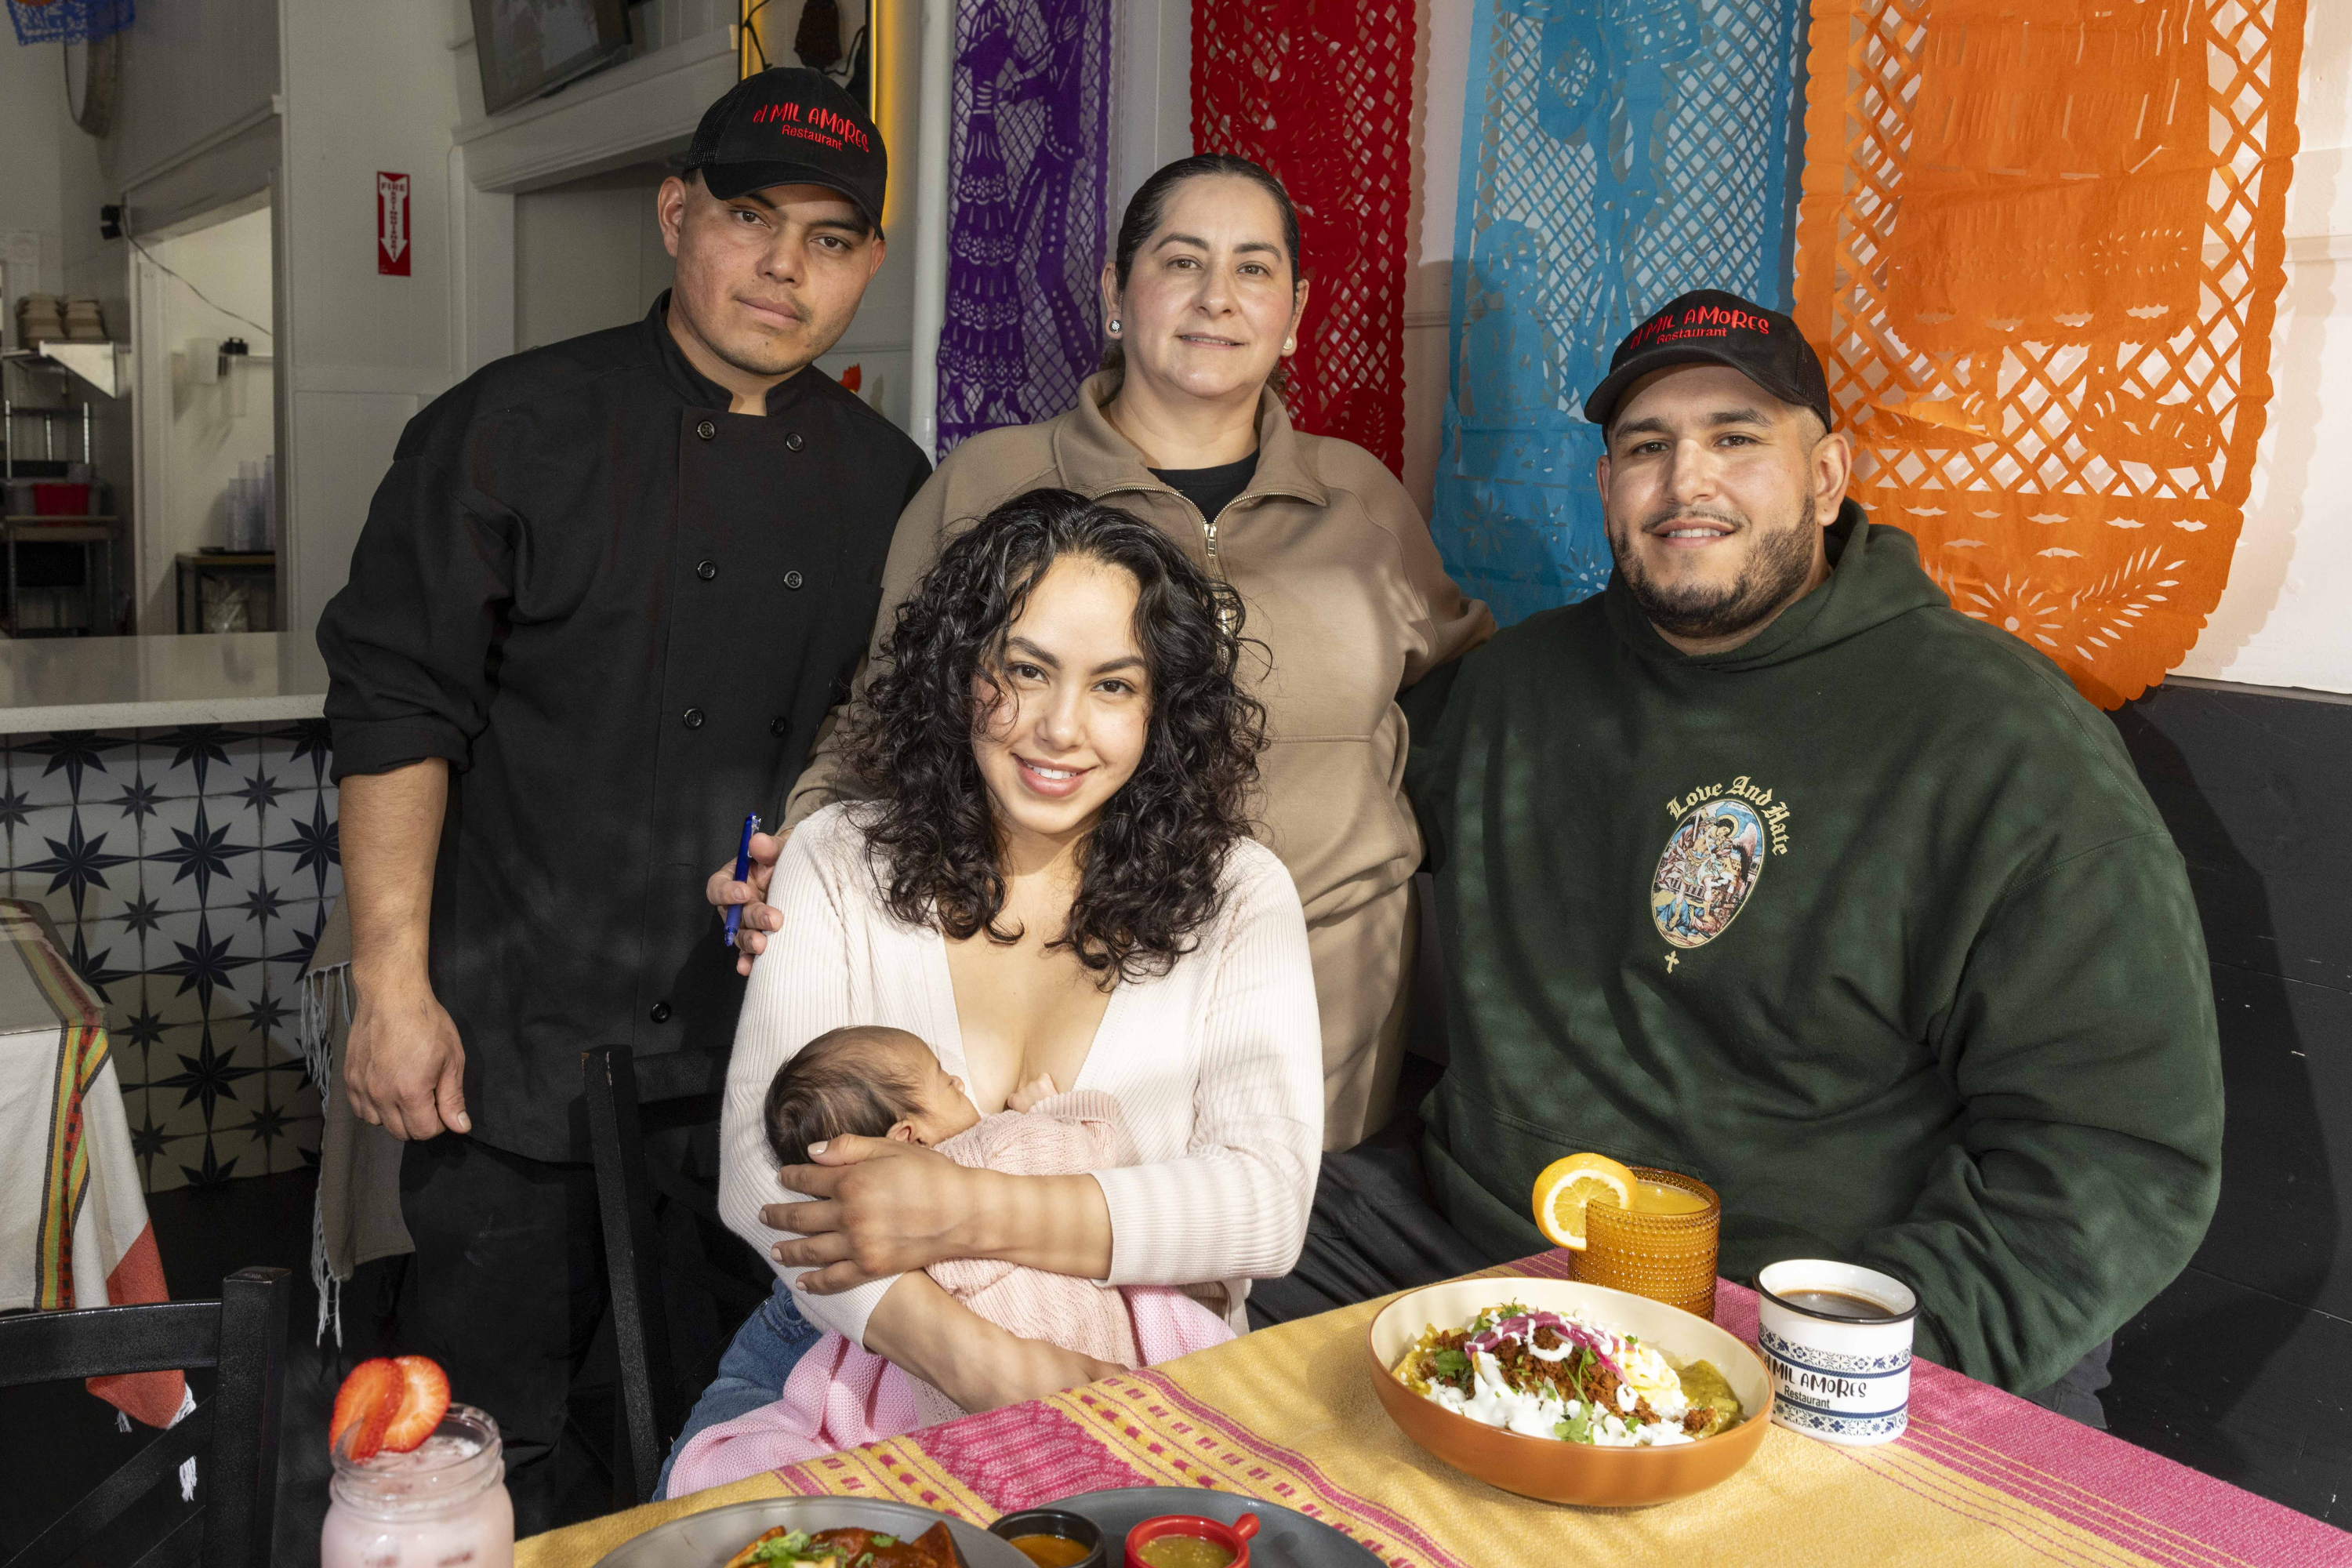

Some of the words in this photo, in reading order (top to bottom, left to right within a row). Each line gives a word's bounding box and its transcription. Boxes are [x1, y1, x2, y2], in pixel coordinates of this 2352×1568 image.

[753, 104, 768, 123] el
[769, 103, 801, 123] MIL
[808, 107, 869, 152] AMORES
[782, 124, 842, 151] Restaurant
[381, 183, 405, 192] FIRE
[1644, 314, 1675, 340] MIL
[1683, 306, 1769, 334] AMORES
[1657, 327, 1727, 344] Restaurant
[1666, 782, 1723, 821] Love
[1726, 775, 1773, 807] And
[1761, 801, 1790, 856] Hate
[1773, 1359, 1795, 1384] MIL
[1800, 1373, 1867, 1398] AMORES
[1784, 1385, 1830, 1409] Restaurant
